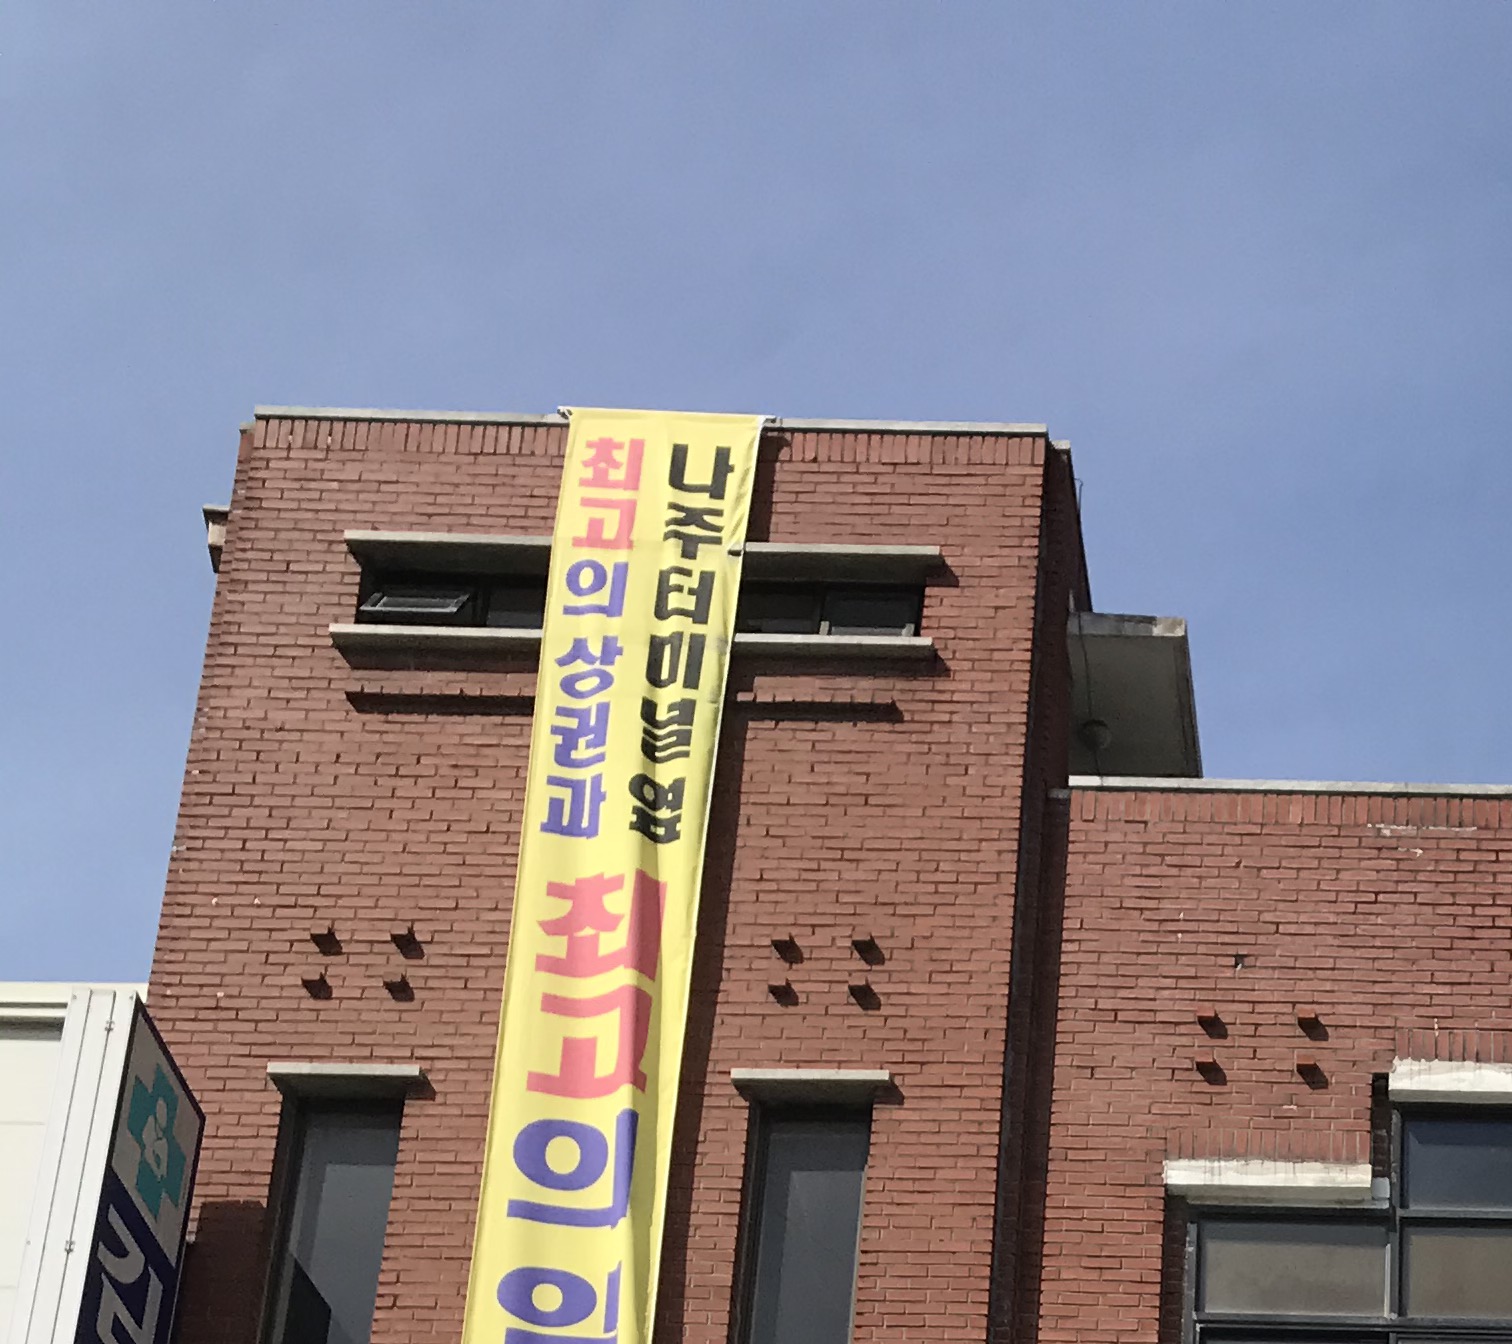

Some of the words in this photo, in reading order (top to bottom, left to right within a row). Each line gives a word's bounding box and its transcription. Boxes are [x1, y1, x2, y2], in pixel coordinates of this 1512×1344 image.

[561, 435, 645, 618] 최고의
[638, 442, 735, 764] 나주터미널
[539, 634, 624, 839] 상권과
[627, 774, 685, 845] 앞
[506, 867, 668, 1230] 최고의
